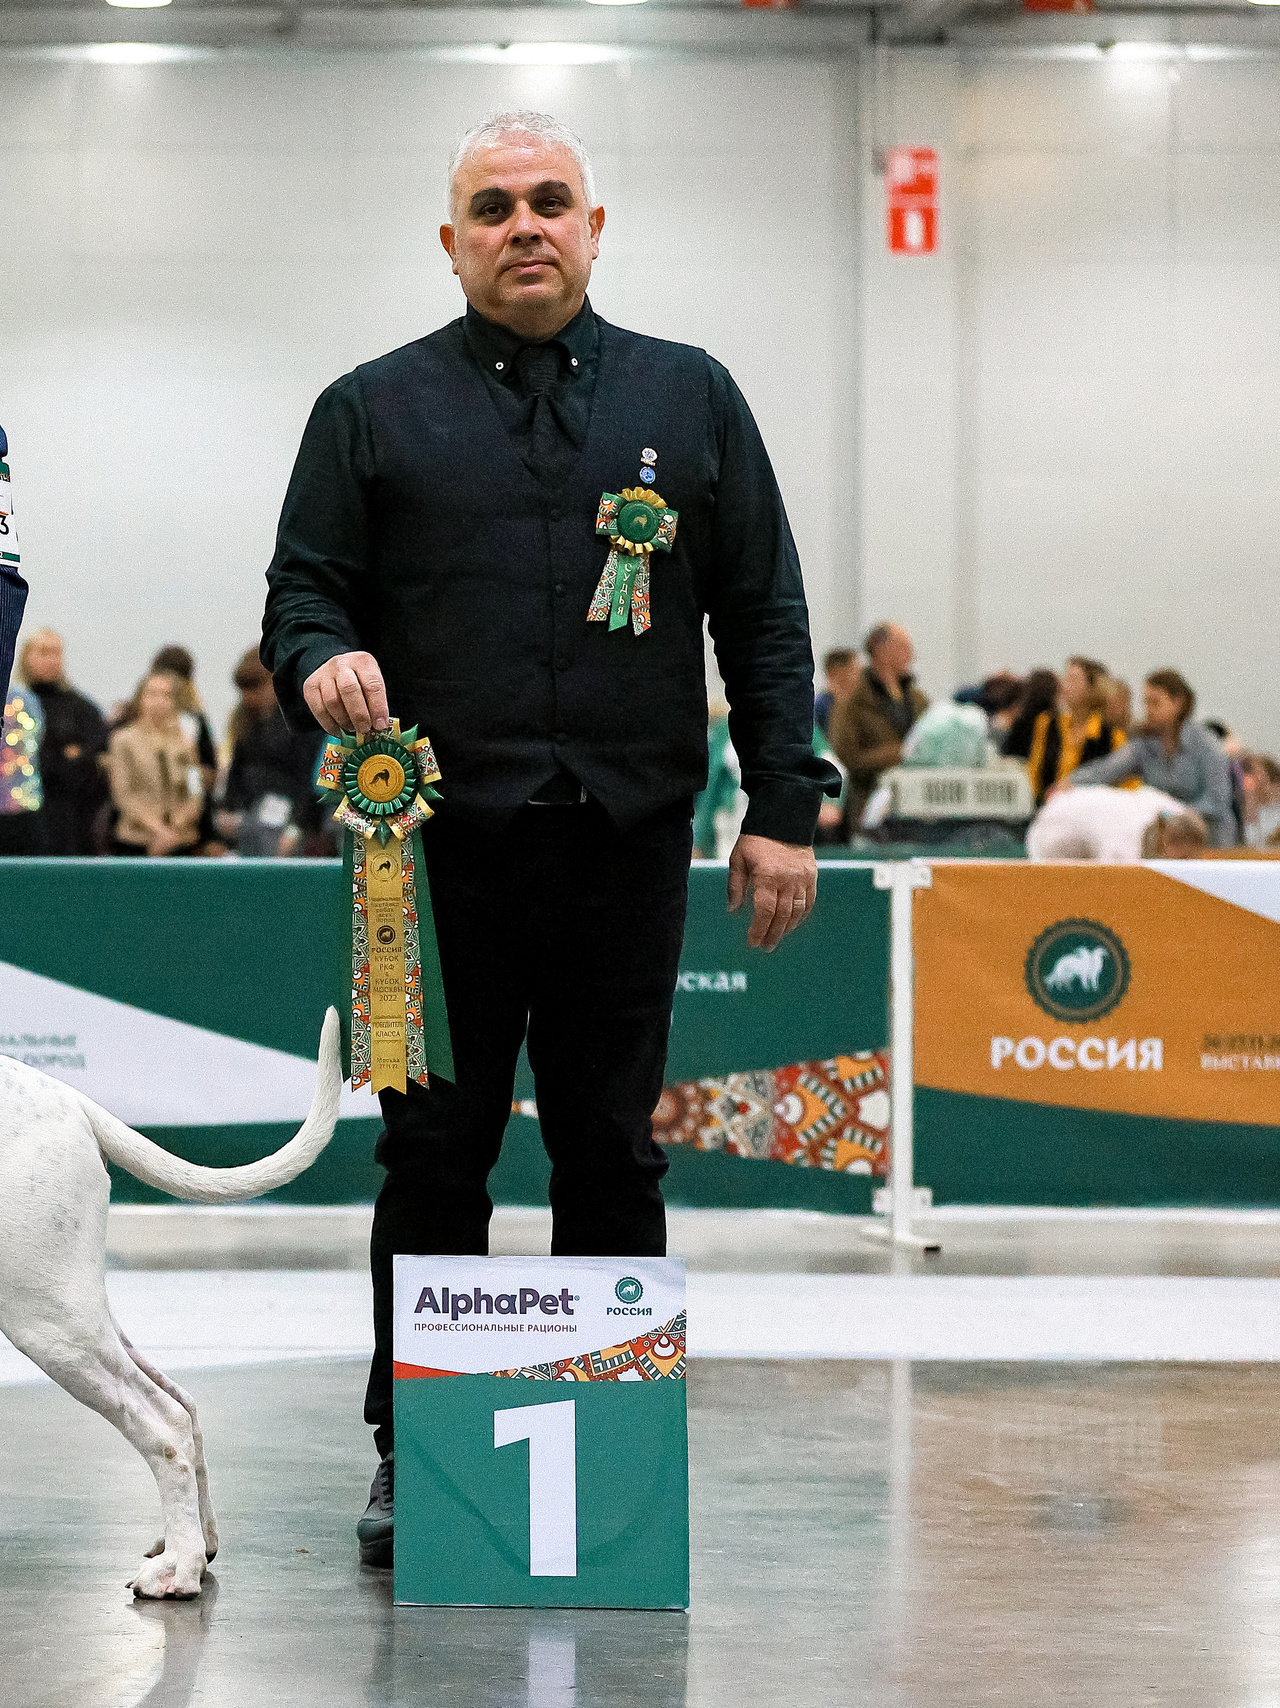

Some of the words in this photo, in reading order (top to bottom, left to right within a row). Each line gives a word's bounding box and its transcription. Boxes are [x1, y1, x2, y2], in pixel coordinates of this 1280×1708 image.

[617, 563, 632, 616] СУДЬЯ
[990, 1036, 1164, 1071] РОССИЯ
[414, 1323, 525, 1332] ПРОФЕССИОНАЛЬНЫЕ
[527, 1324, 577, 1333] РАЦИОНЫ
[606, 1307, 652, 1316] РОССИЯ
[493, 1399, 577, 1577] 1
